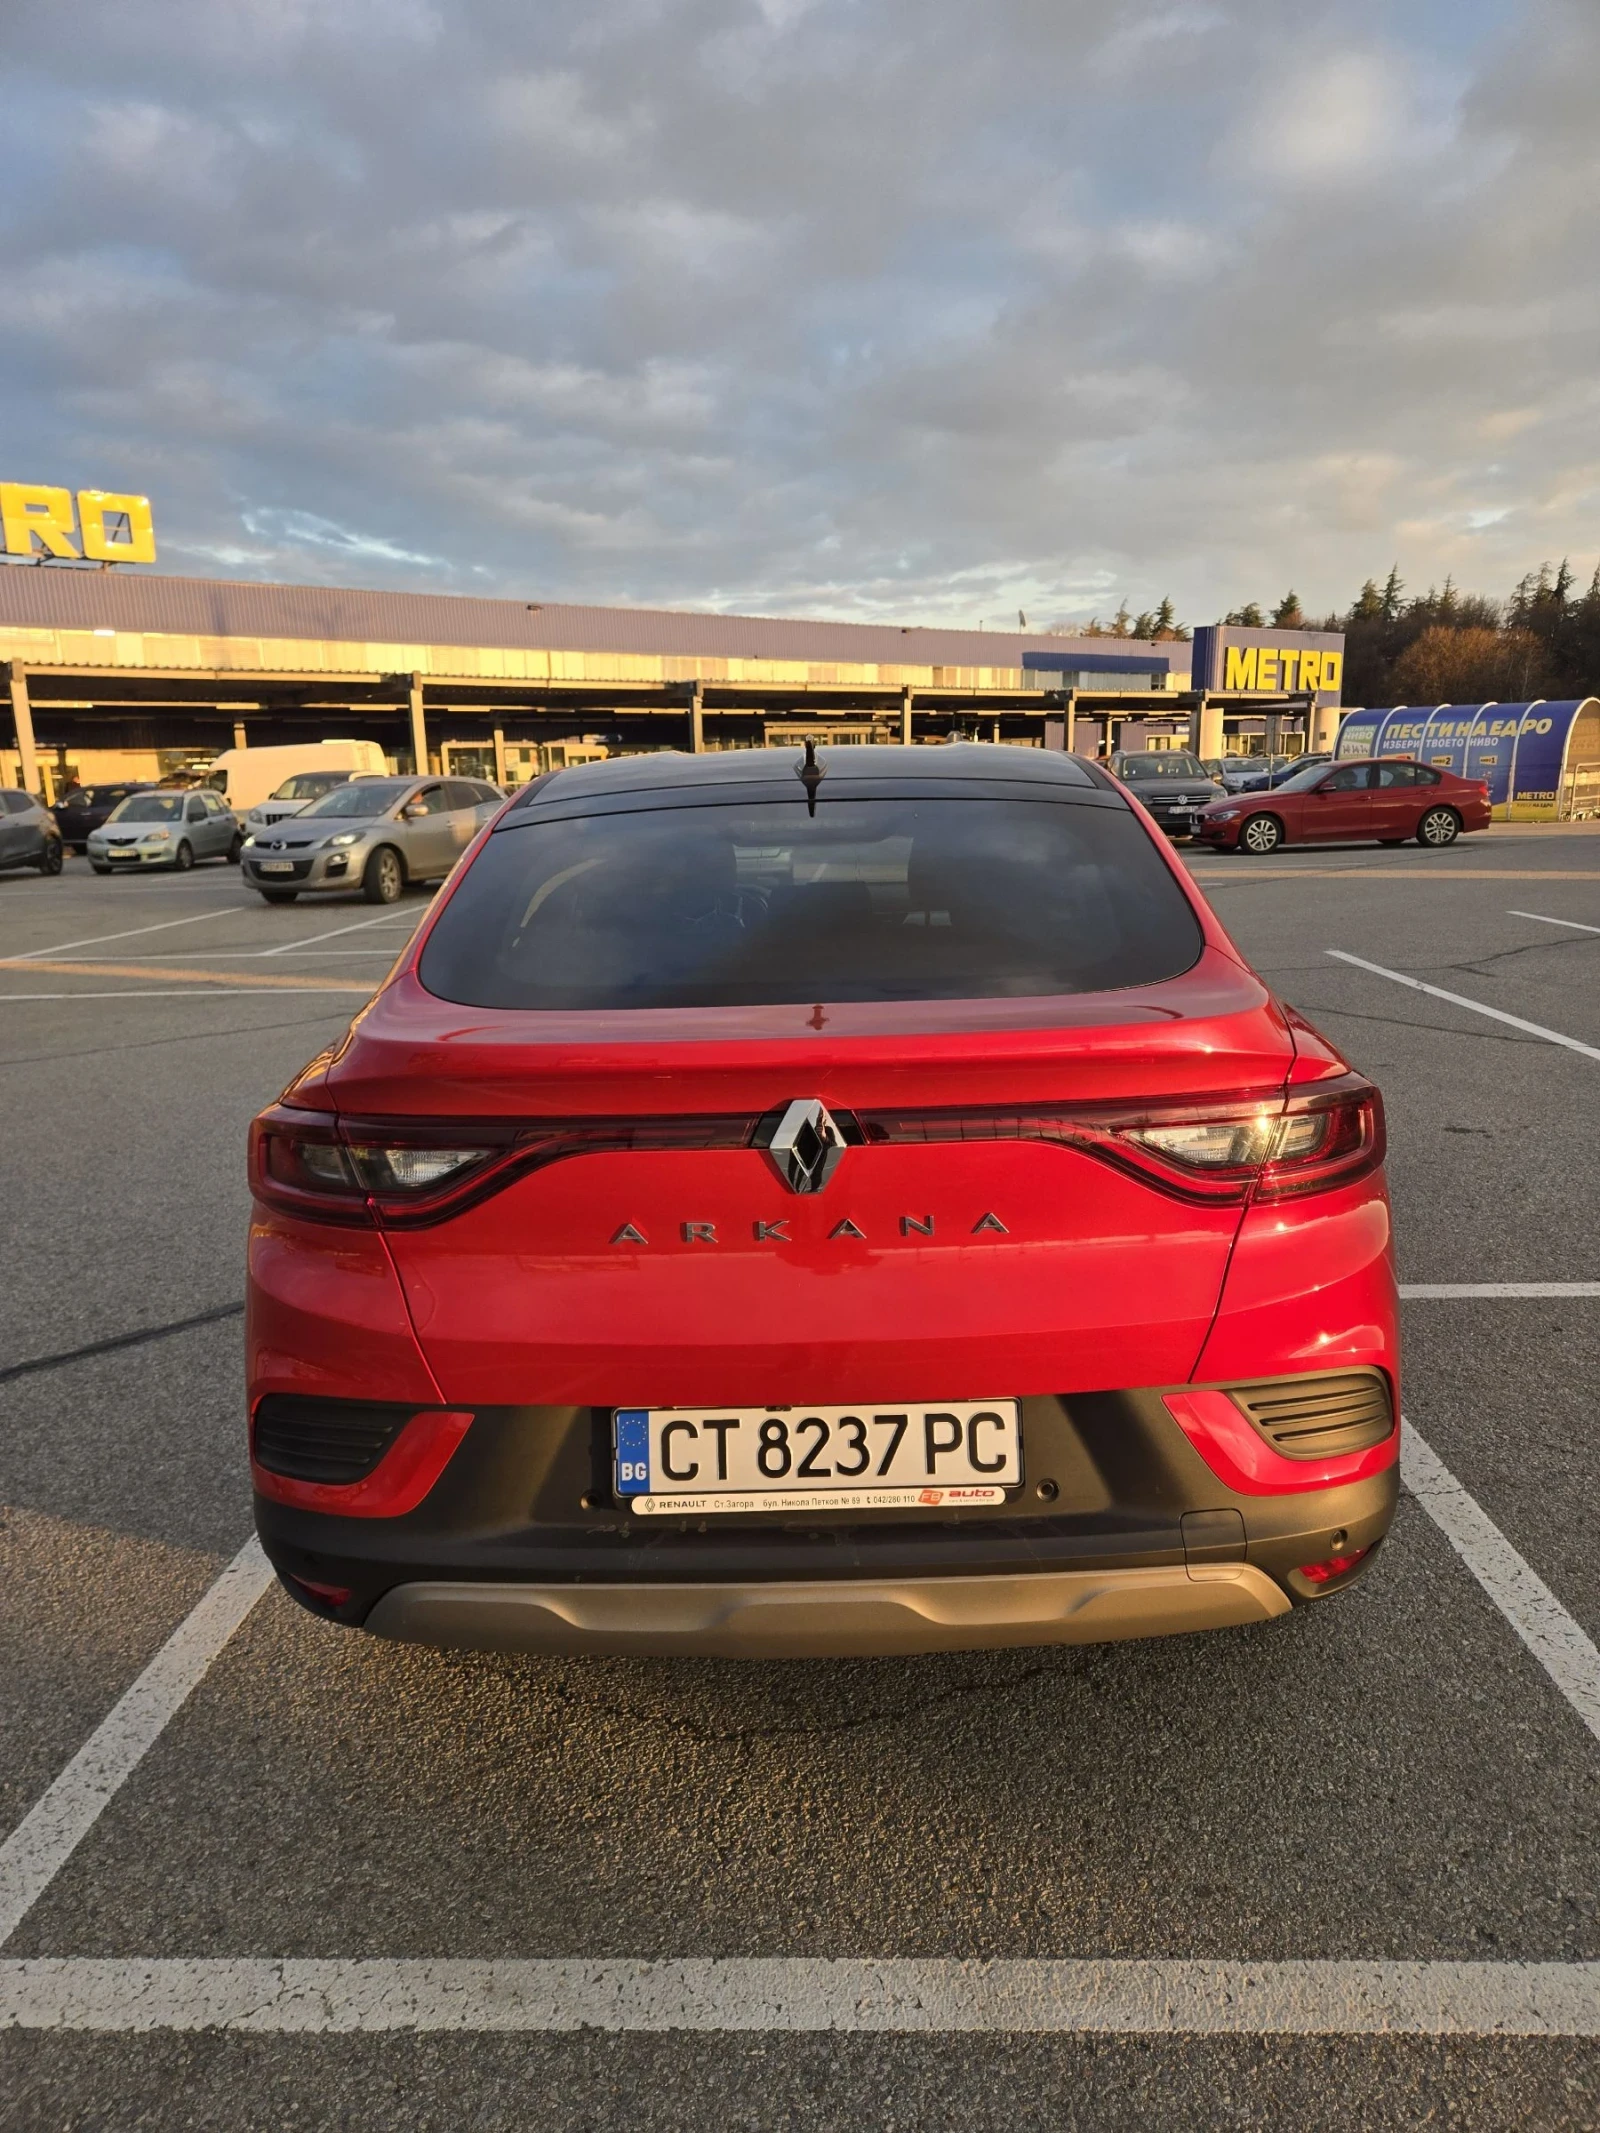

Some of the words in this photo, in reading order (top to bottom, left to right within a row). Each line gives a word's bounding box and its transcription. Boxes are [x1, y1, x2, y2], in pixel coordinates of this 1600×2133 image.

[1225, 646, 1342, 692] METRO
[1385, 722, 1455, 740] ПЕСТИ
[1455, 721, 1488, 737] НА
[1489, 718, 1553, 738] ЕДРО
[1383, 740, 1420, 749] ИЗБЕРИ
[1426, 739, 1464, 748] ТВОЕТО
[1469, 737, 1499, 747] НИВО
[1445, 757, 1451, 765] 2
[1517, 792, 1554, 800] METRO
[609, 1212, 1010, 1245] ARKANA
[660, 1419, 740, 1481] CT
[757, 1414, 908, 1478] 8237
[924, 1412, 1007, 1475] PC
[621, 1462, 647, 1481] BG
[949, 1489, 995, 1497] auto
[659, 1500, 707, 1509] RENAULT
[781, 1498, 809, 1507] Никола
[811, 1497, 839, 1506] Петков
